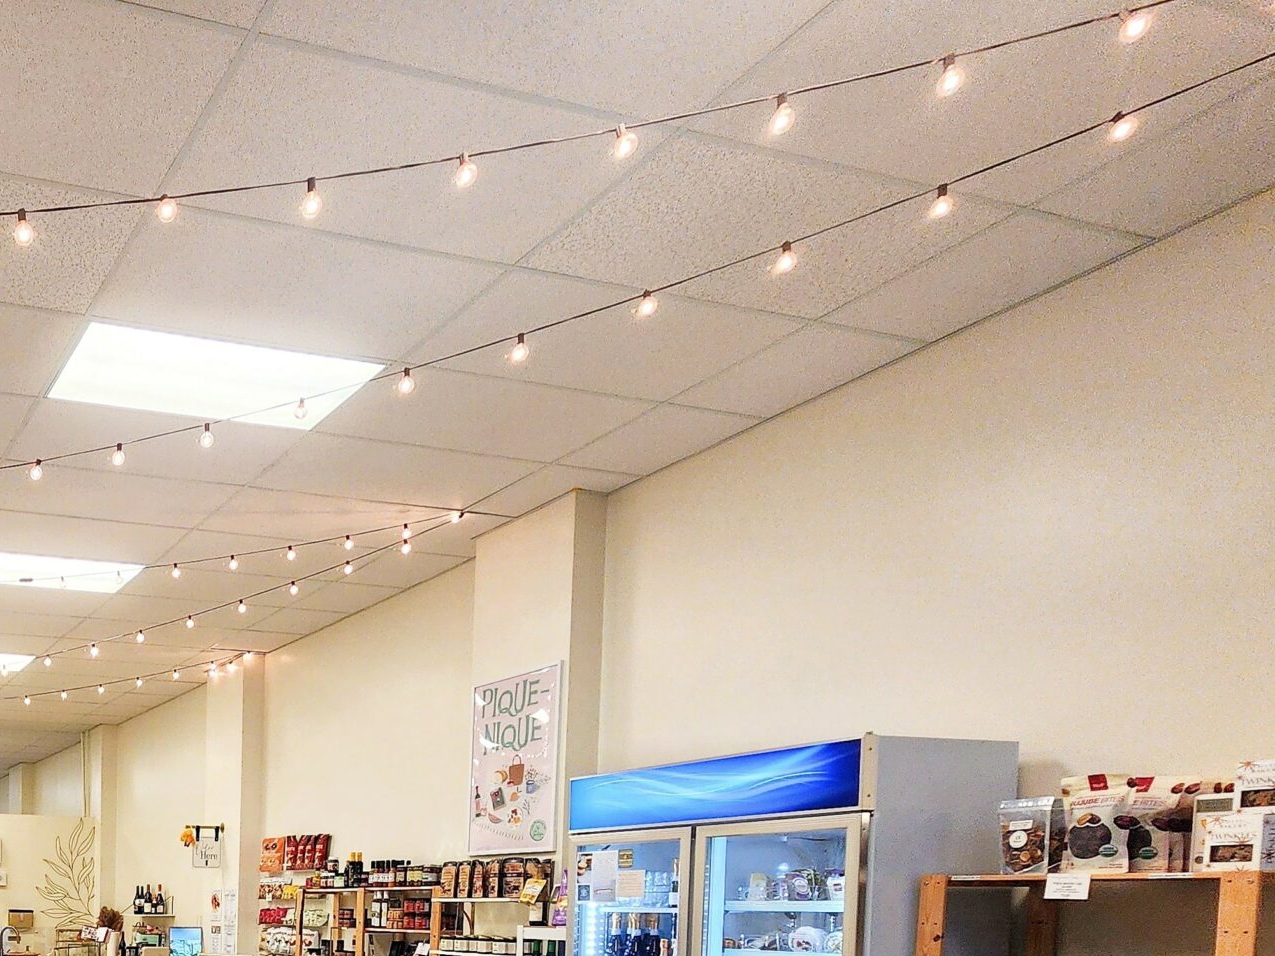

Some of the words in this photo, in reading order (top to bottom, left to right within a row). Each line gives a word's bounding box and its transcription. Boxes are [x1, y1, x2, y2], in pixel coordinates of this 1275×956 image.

[482, 679, 550, 718] PIQUE-
[483, 714, 543, 755] NIQUE
[200, 850, 217, 860] Here
